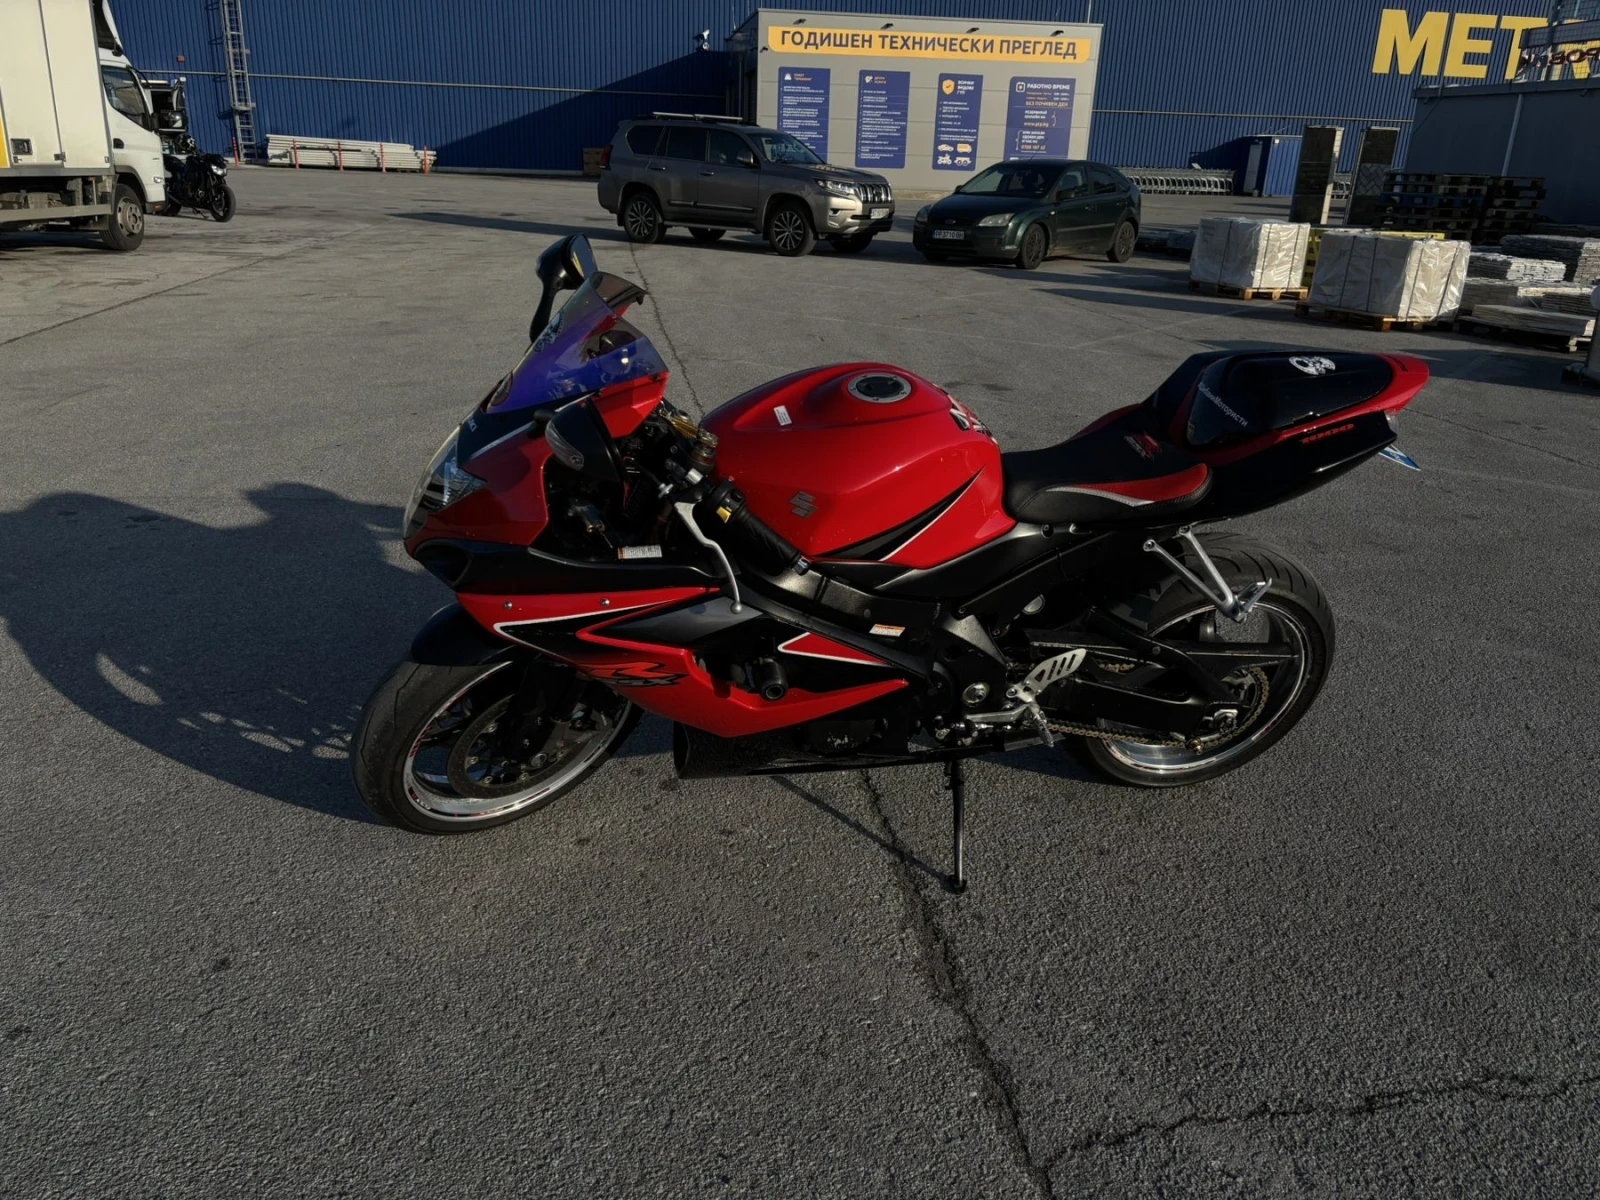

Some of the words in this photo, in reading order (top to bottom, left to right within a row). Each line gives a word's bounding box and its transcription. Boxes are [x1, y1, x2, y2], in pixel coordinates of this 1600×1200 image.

[781, 30, 873, 50] ГОДИШЕН
[878, 34, 994, 54] ТЕХНИЧЕСКИ
[999, 39, 1077, 60] ПРЕГЛЕД
